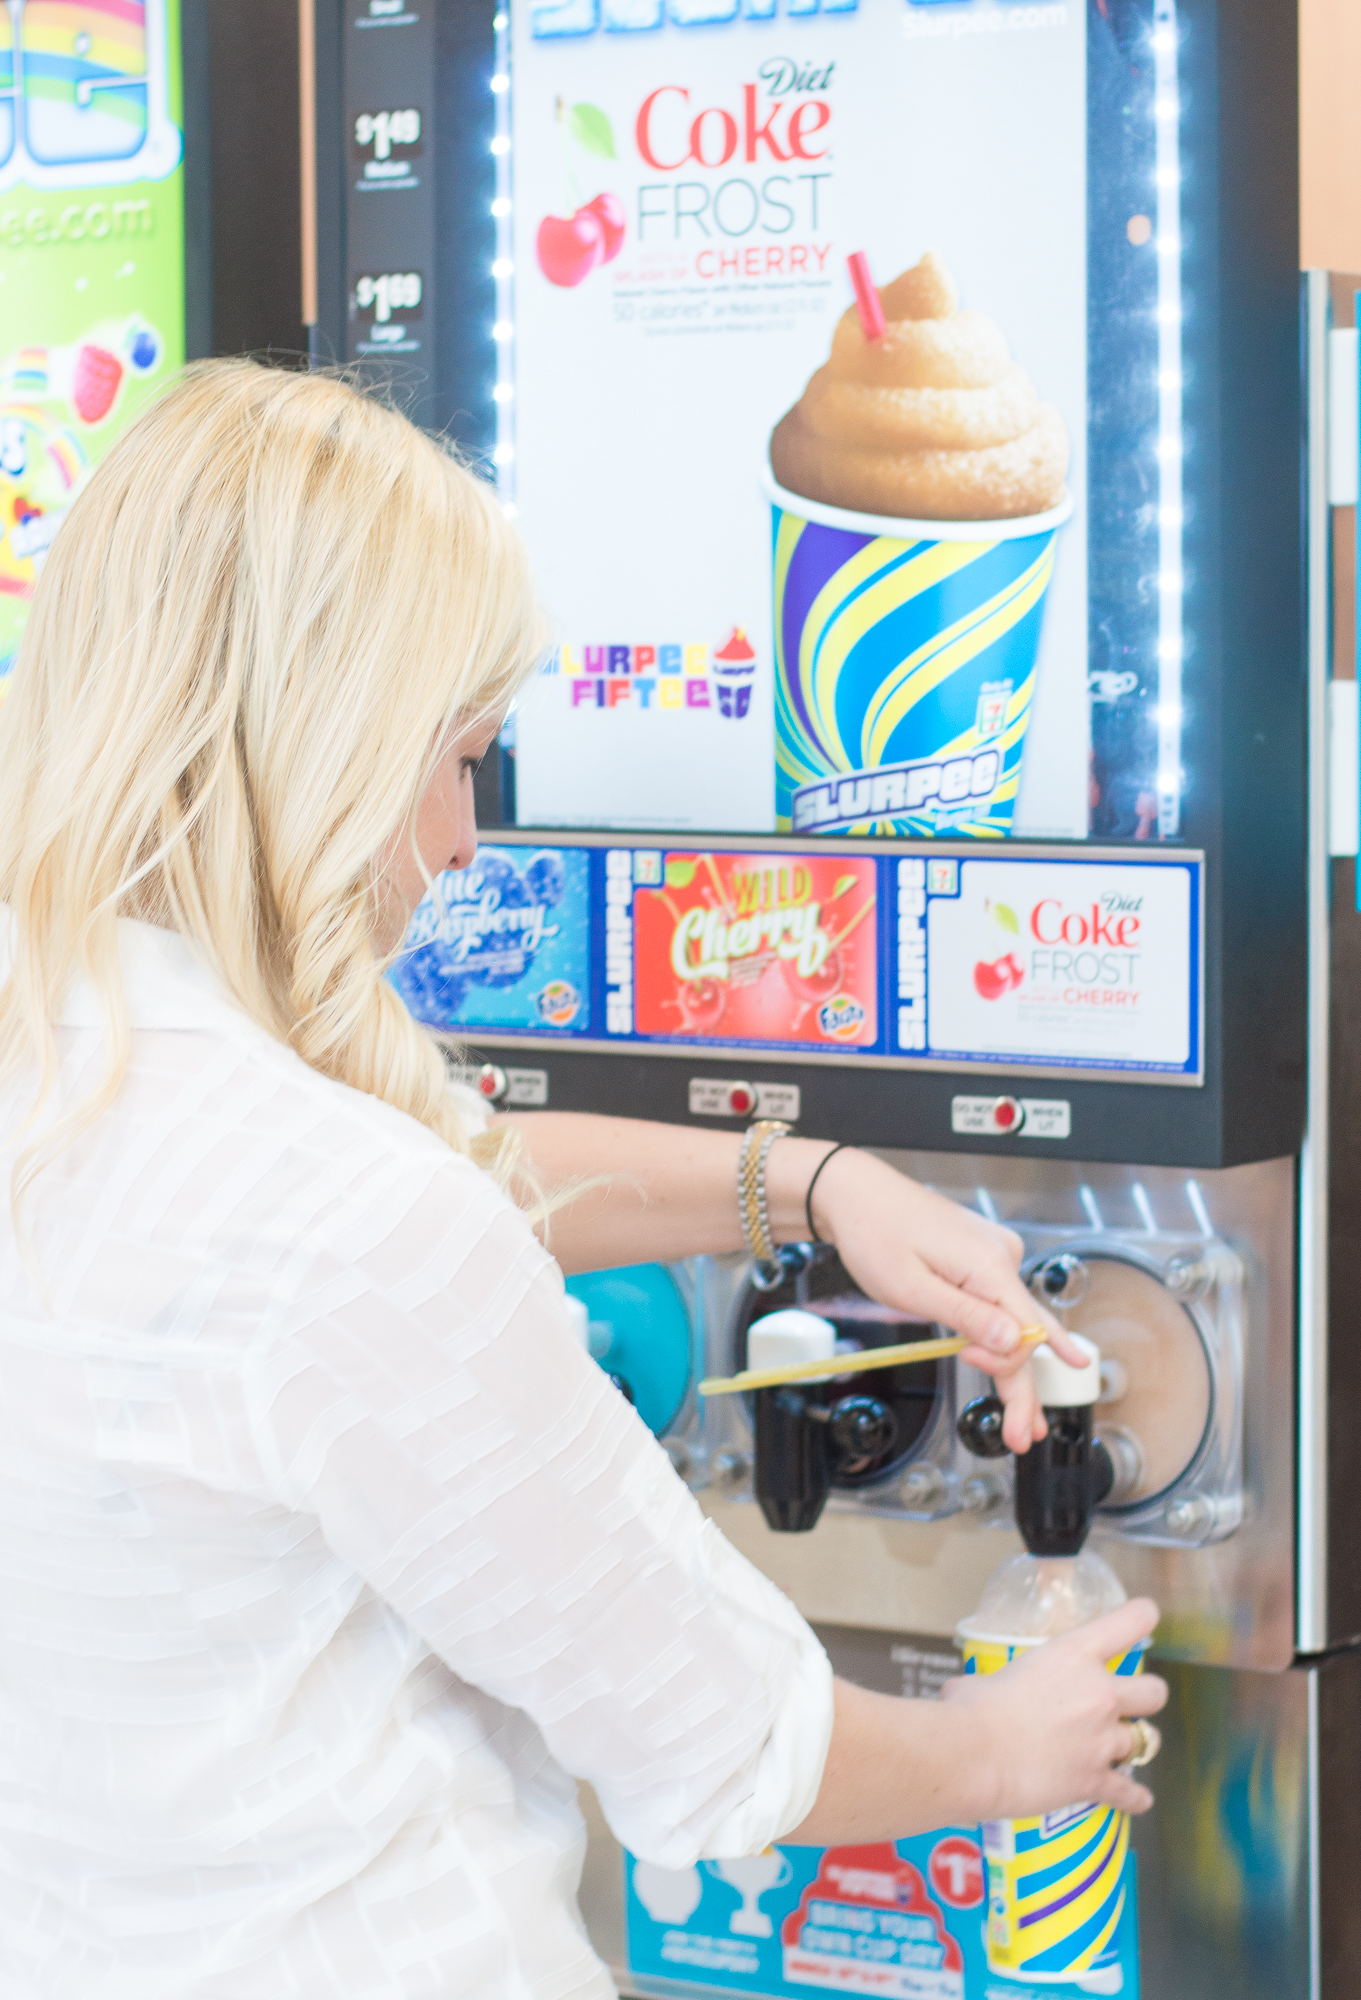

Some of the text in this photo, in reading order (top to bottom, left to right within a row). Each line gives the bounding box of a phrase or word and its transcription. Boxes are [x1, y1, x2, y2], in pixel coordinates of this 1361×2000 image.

[902, 5, 1067, 40] Slurpee.com
[759, 57, 836, 97] Diet
[635, 83, 832, 171] Coke
[637, 173, 832, 241] FROST
[695, 243, 832, 278] CHERRY
[571, 678, 711, 708] FIFTEE
[793, 748, 1000, 832] SLURPEE
[733, 864, 813, 913] WILD
[1101, 891, 1143, 912] Diet
[606, 850, 632, 1034] SLURPEE
[671, 902, 829, 978] Cherry
[1030, 898, 1141, 948] Coke
[898, 858, 926, 1050] SLURPEE
[1031, 949, 1141, 985] FROST
[1063, 988, 1140, 1007] CHERRY
